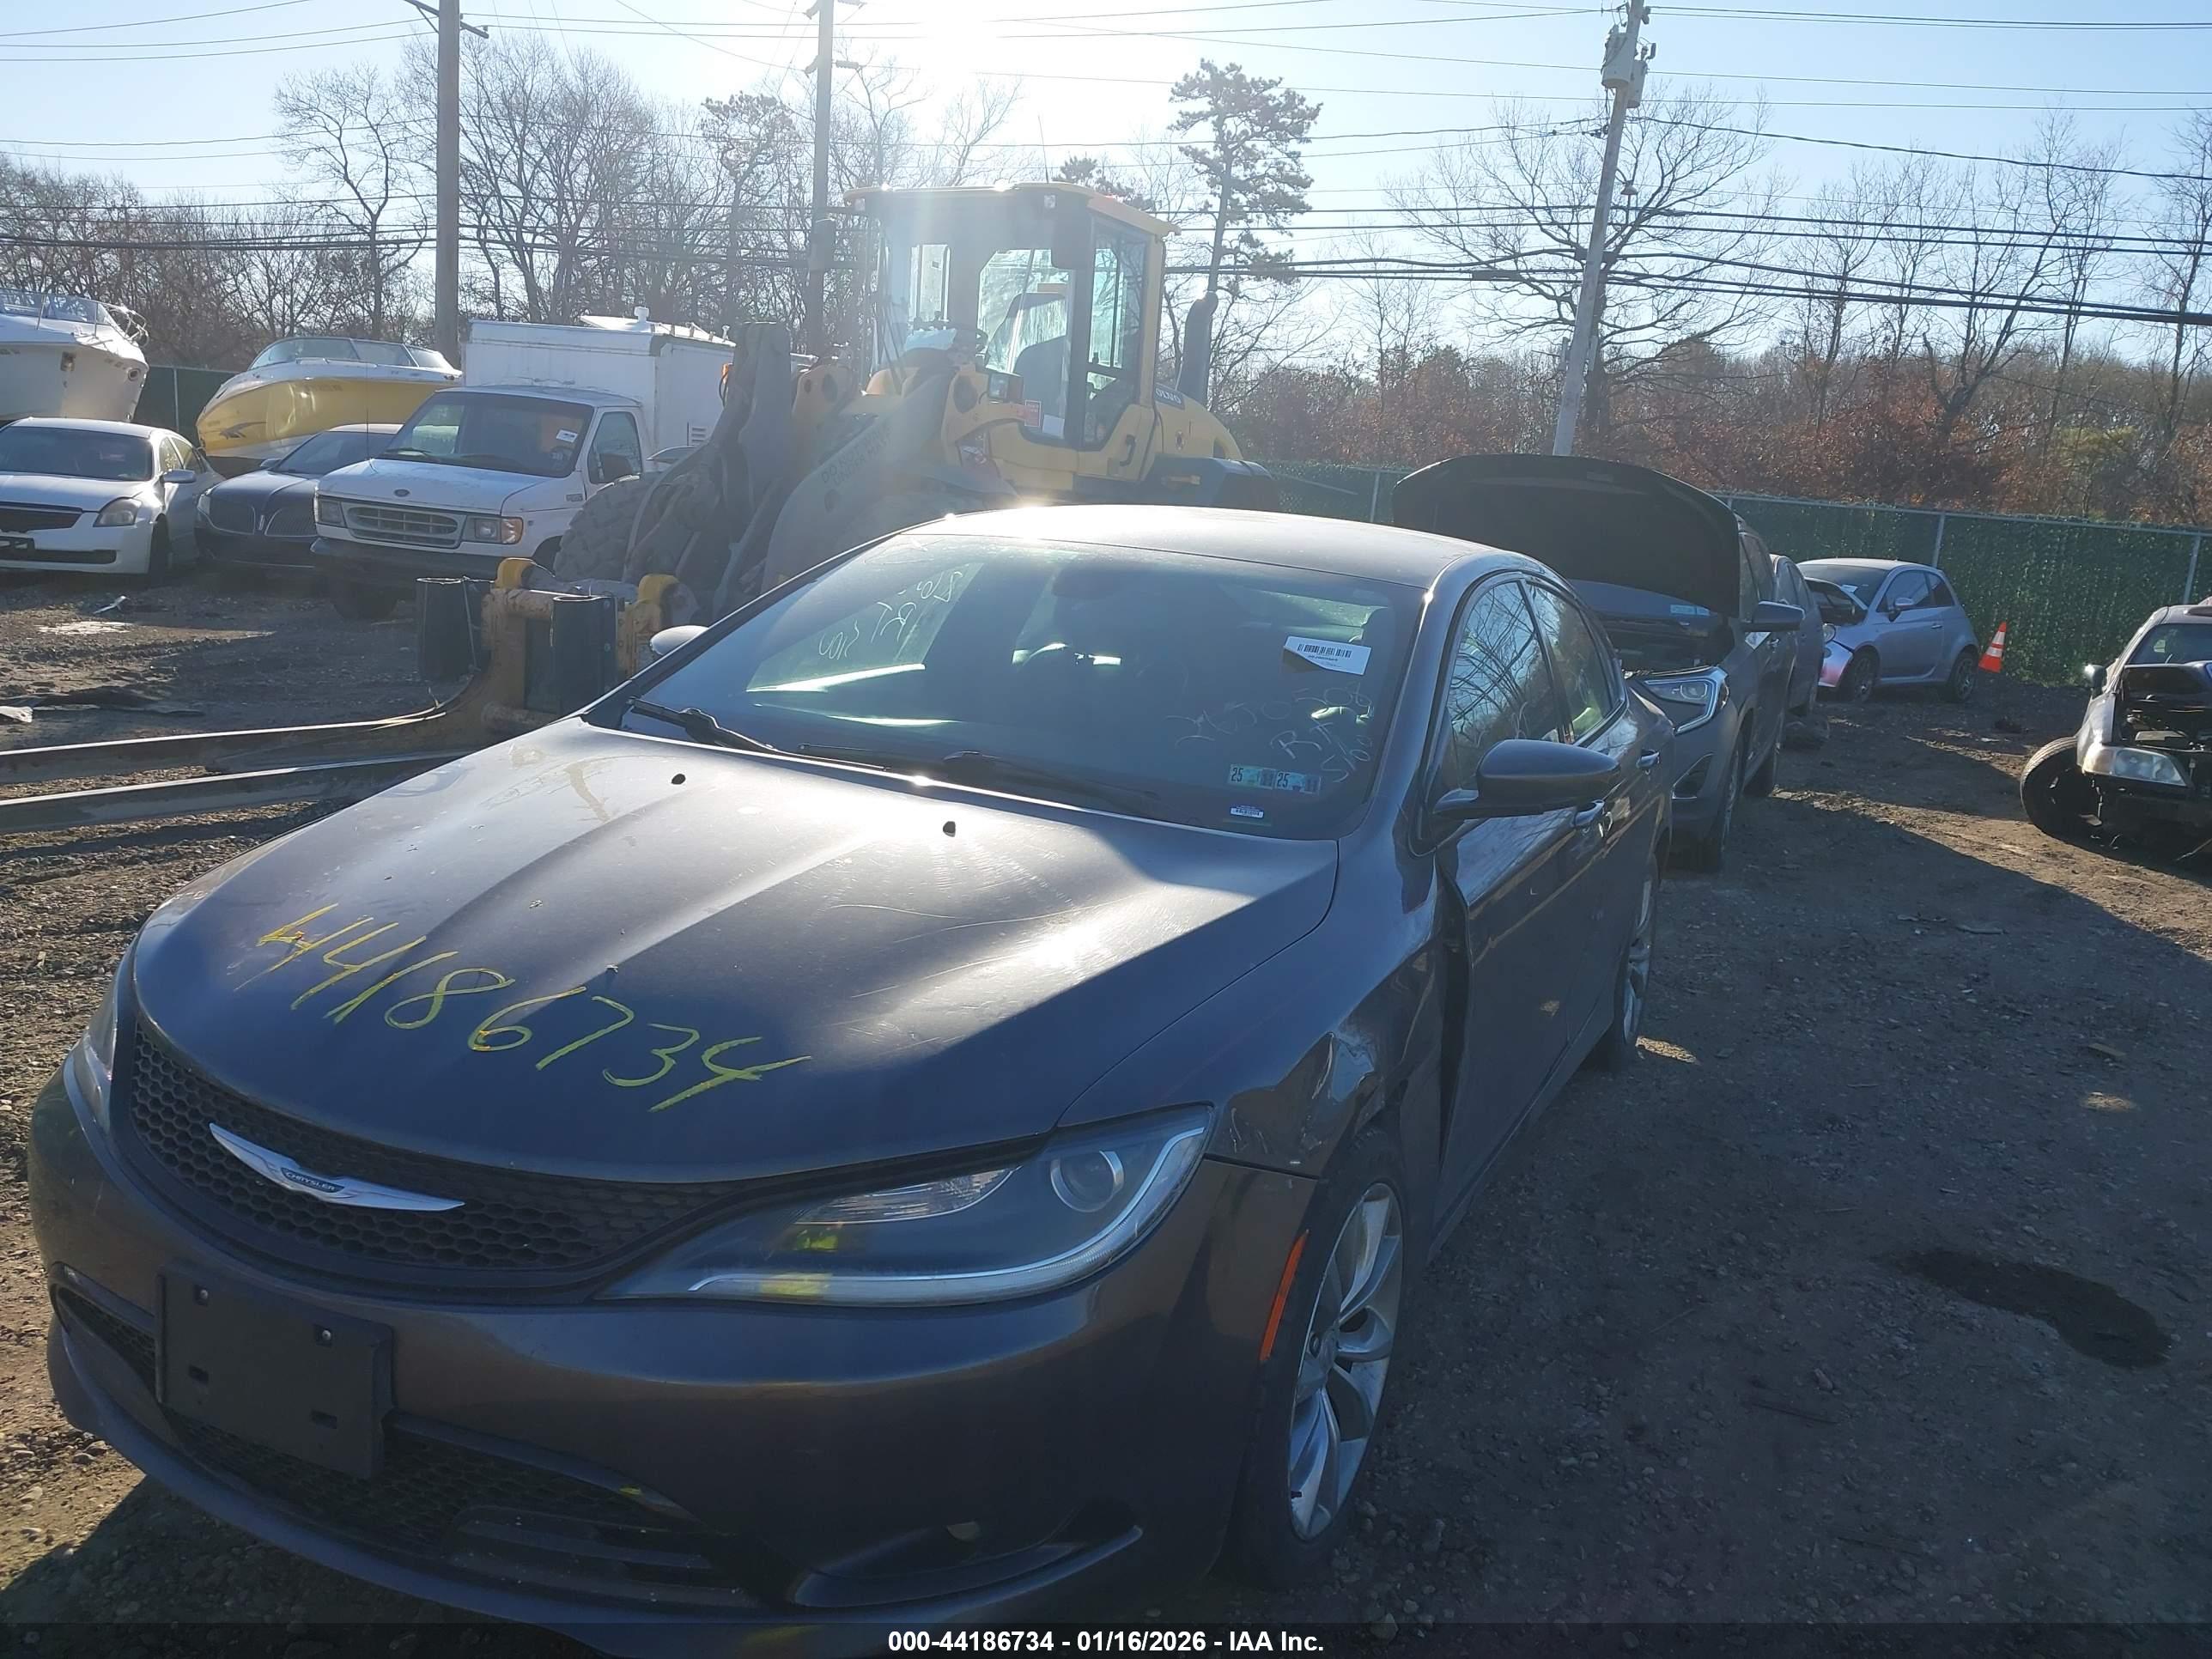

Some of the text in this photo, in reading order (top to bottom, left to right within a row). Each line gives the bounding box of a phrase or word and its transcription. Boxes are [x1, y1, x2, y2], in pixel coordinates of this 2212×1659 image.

[1155, 387, 1182, 404] OLVO
[1231, 767, 1244, 782] 25
[1276, 772, 1290, 788] 25
[234, 902, 812, 1113] 44186734
